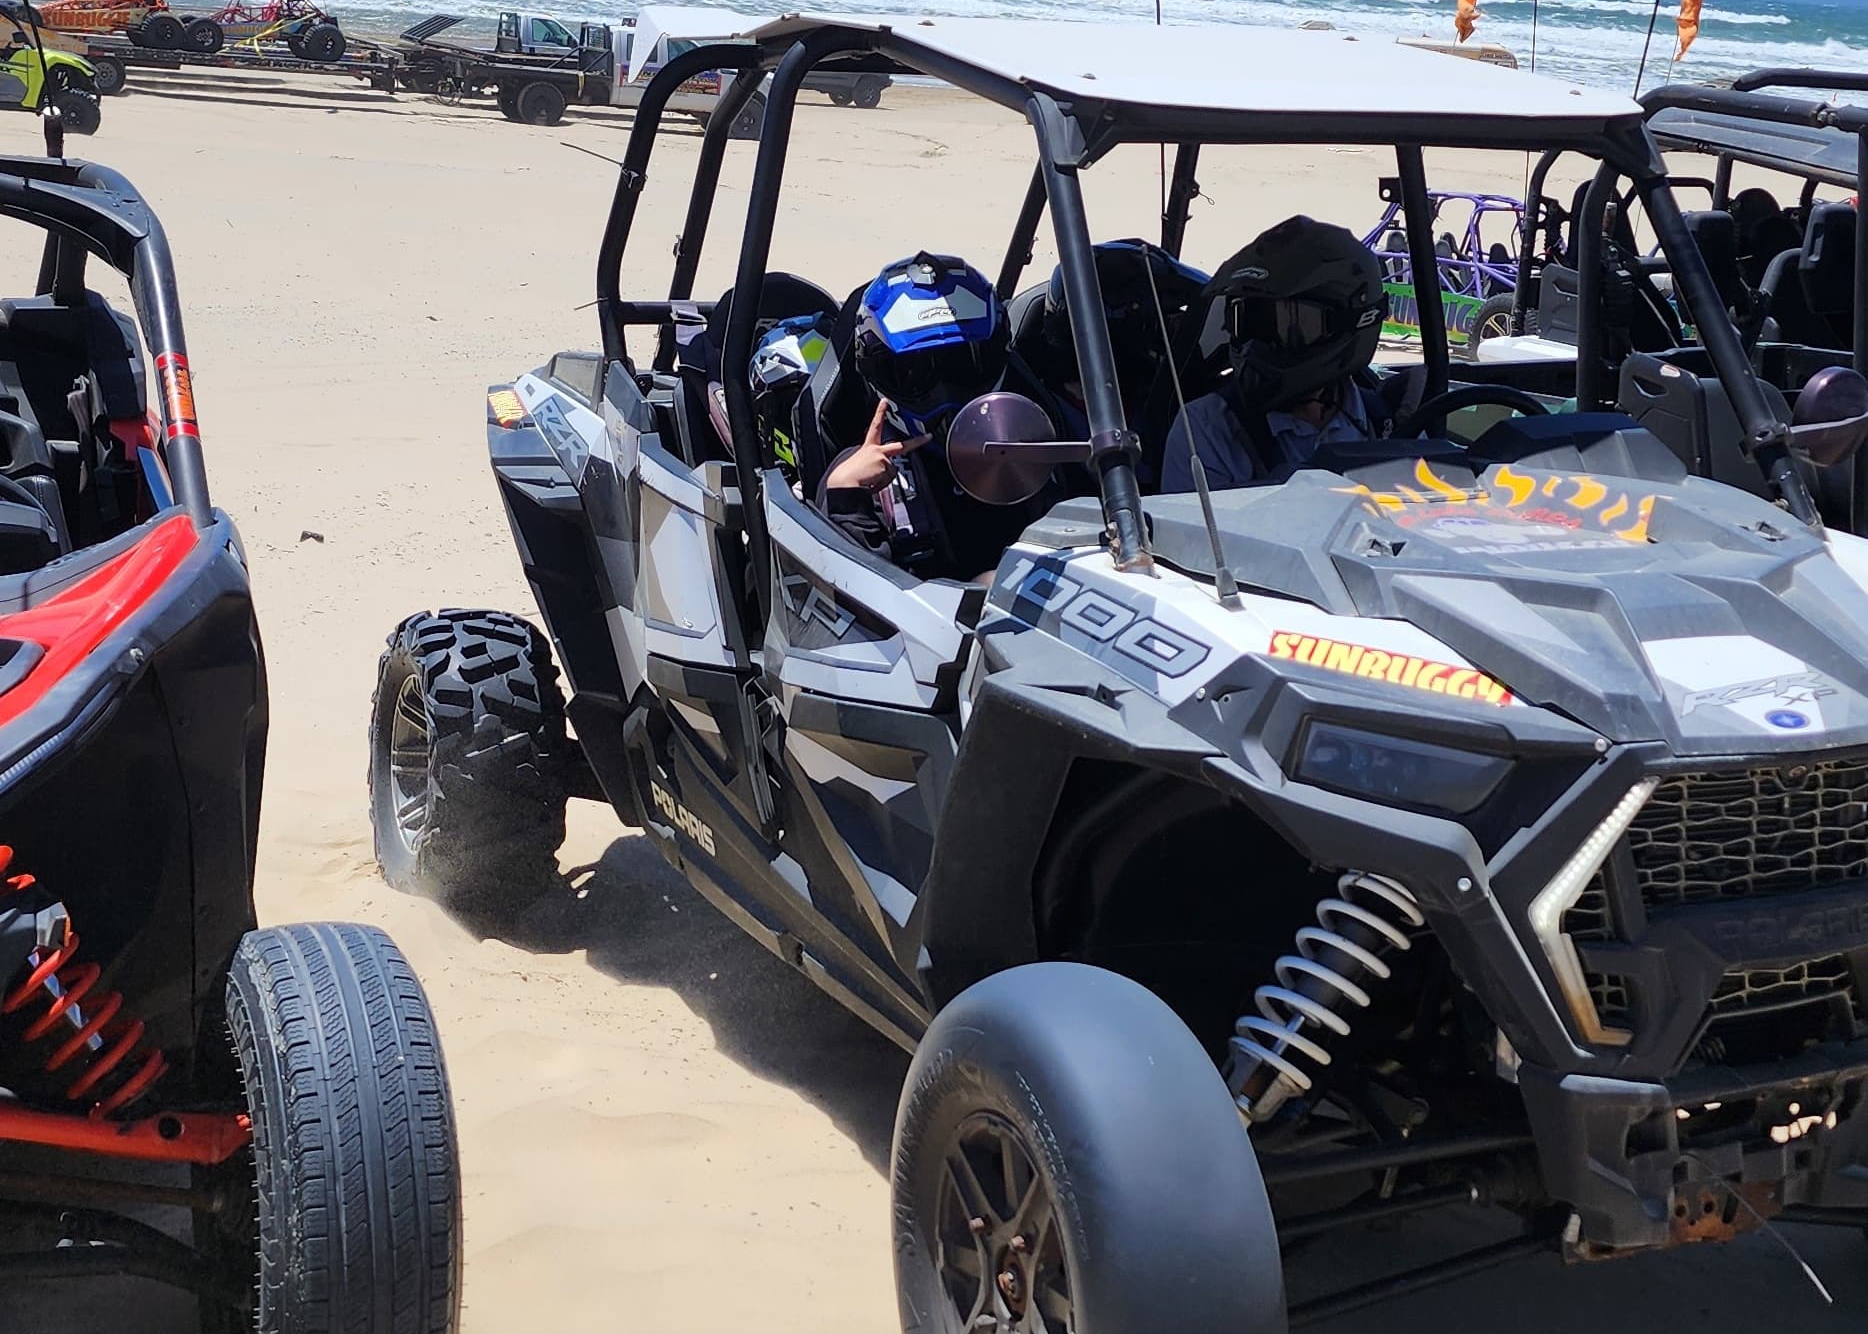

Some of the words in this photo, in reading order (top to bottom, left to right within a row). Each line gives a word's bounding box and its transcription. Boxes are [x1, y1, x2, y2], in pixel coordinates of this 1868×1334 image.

[532, 396, 590, 468] RZR
[1001, 558, 1212, 679] 1000
[1271, 633, 1506, 704] SUNBUGGY
[650, 779, 716, 857] POLARIS
